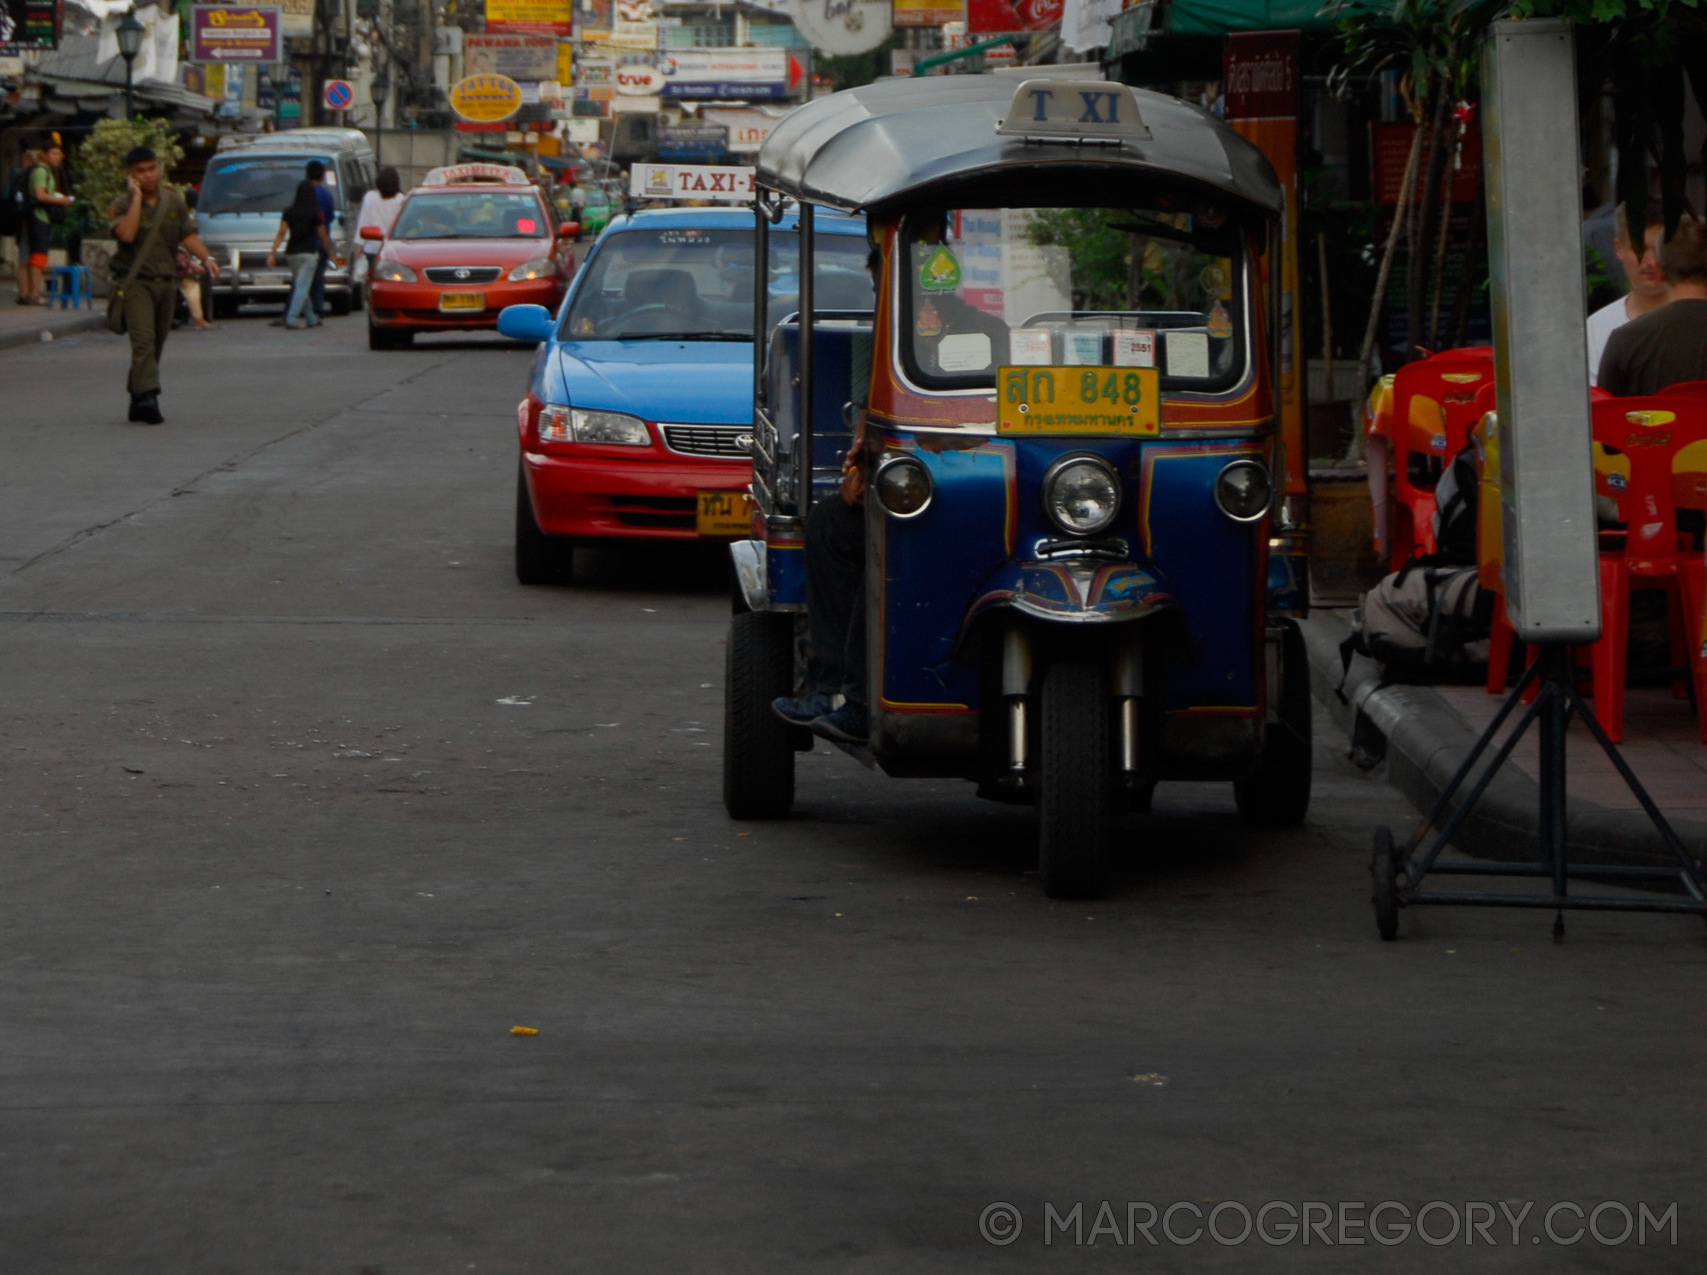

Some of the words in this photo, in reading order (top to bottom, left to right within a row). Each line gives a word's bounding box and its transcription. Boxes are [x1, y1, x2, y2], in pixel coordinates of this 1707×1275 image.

[617, 73, 653, 85] true
[678, 172, 756, 193] TAXI-
[1080, 371, 1141, 405] 848
[1023, 413, 1135, 430] กรุงเทพมหานคร
